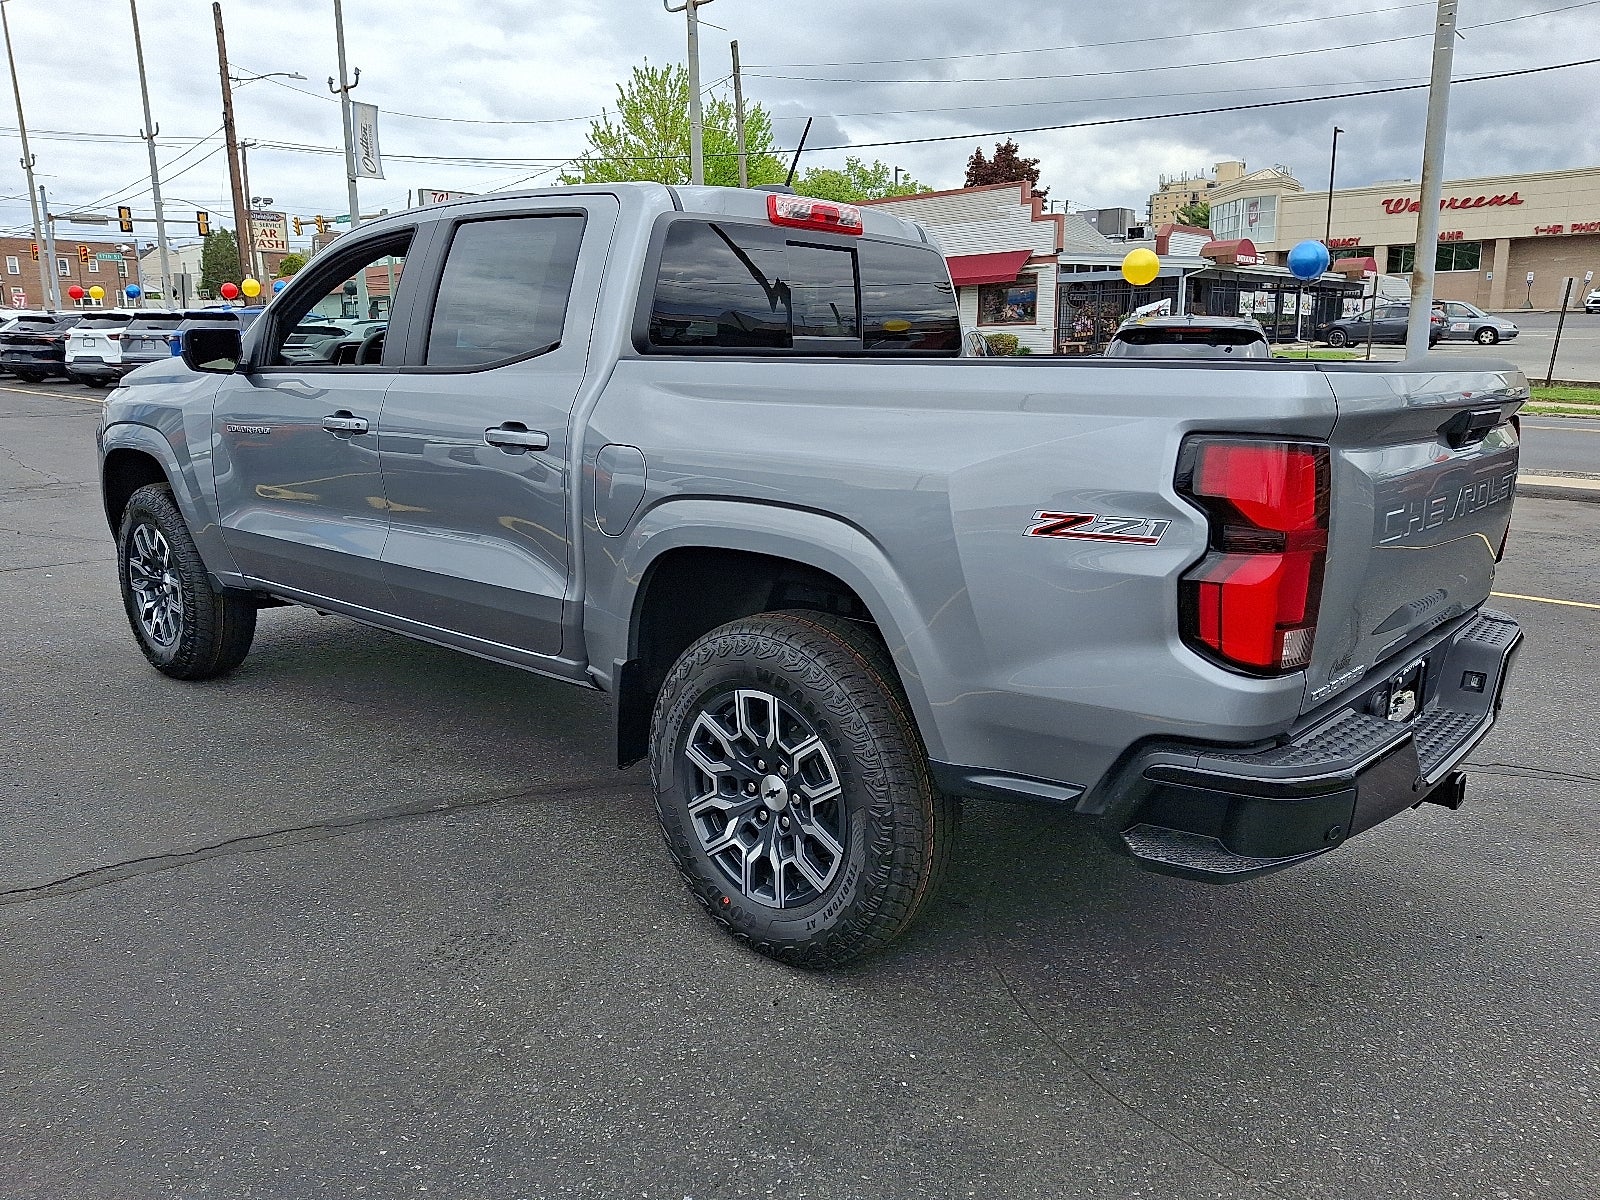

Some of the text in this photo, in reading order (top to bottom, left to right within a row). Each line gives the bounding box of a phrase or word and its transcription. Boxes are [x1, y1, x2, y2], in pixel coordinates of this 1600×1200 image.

[1381, 192, 1525, 215] Wareens
[1437, 230, 1464, 241] 4HR
[1570, 221, 1600, 233] PHO
[1022, 509, 1172, 546] Z71
[822, 861, 859, 922] TERRITORY
